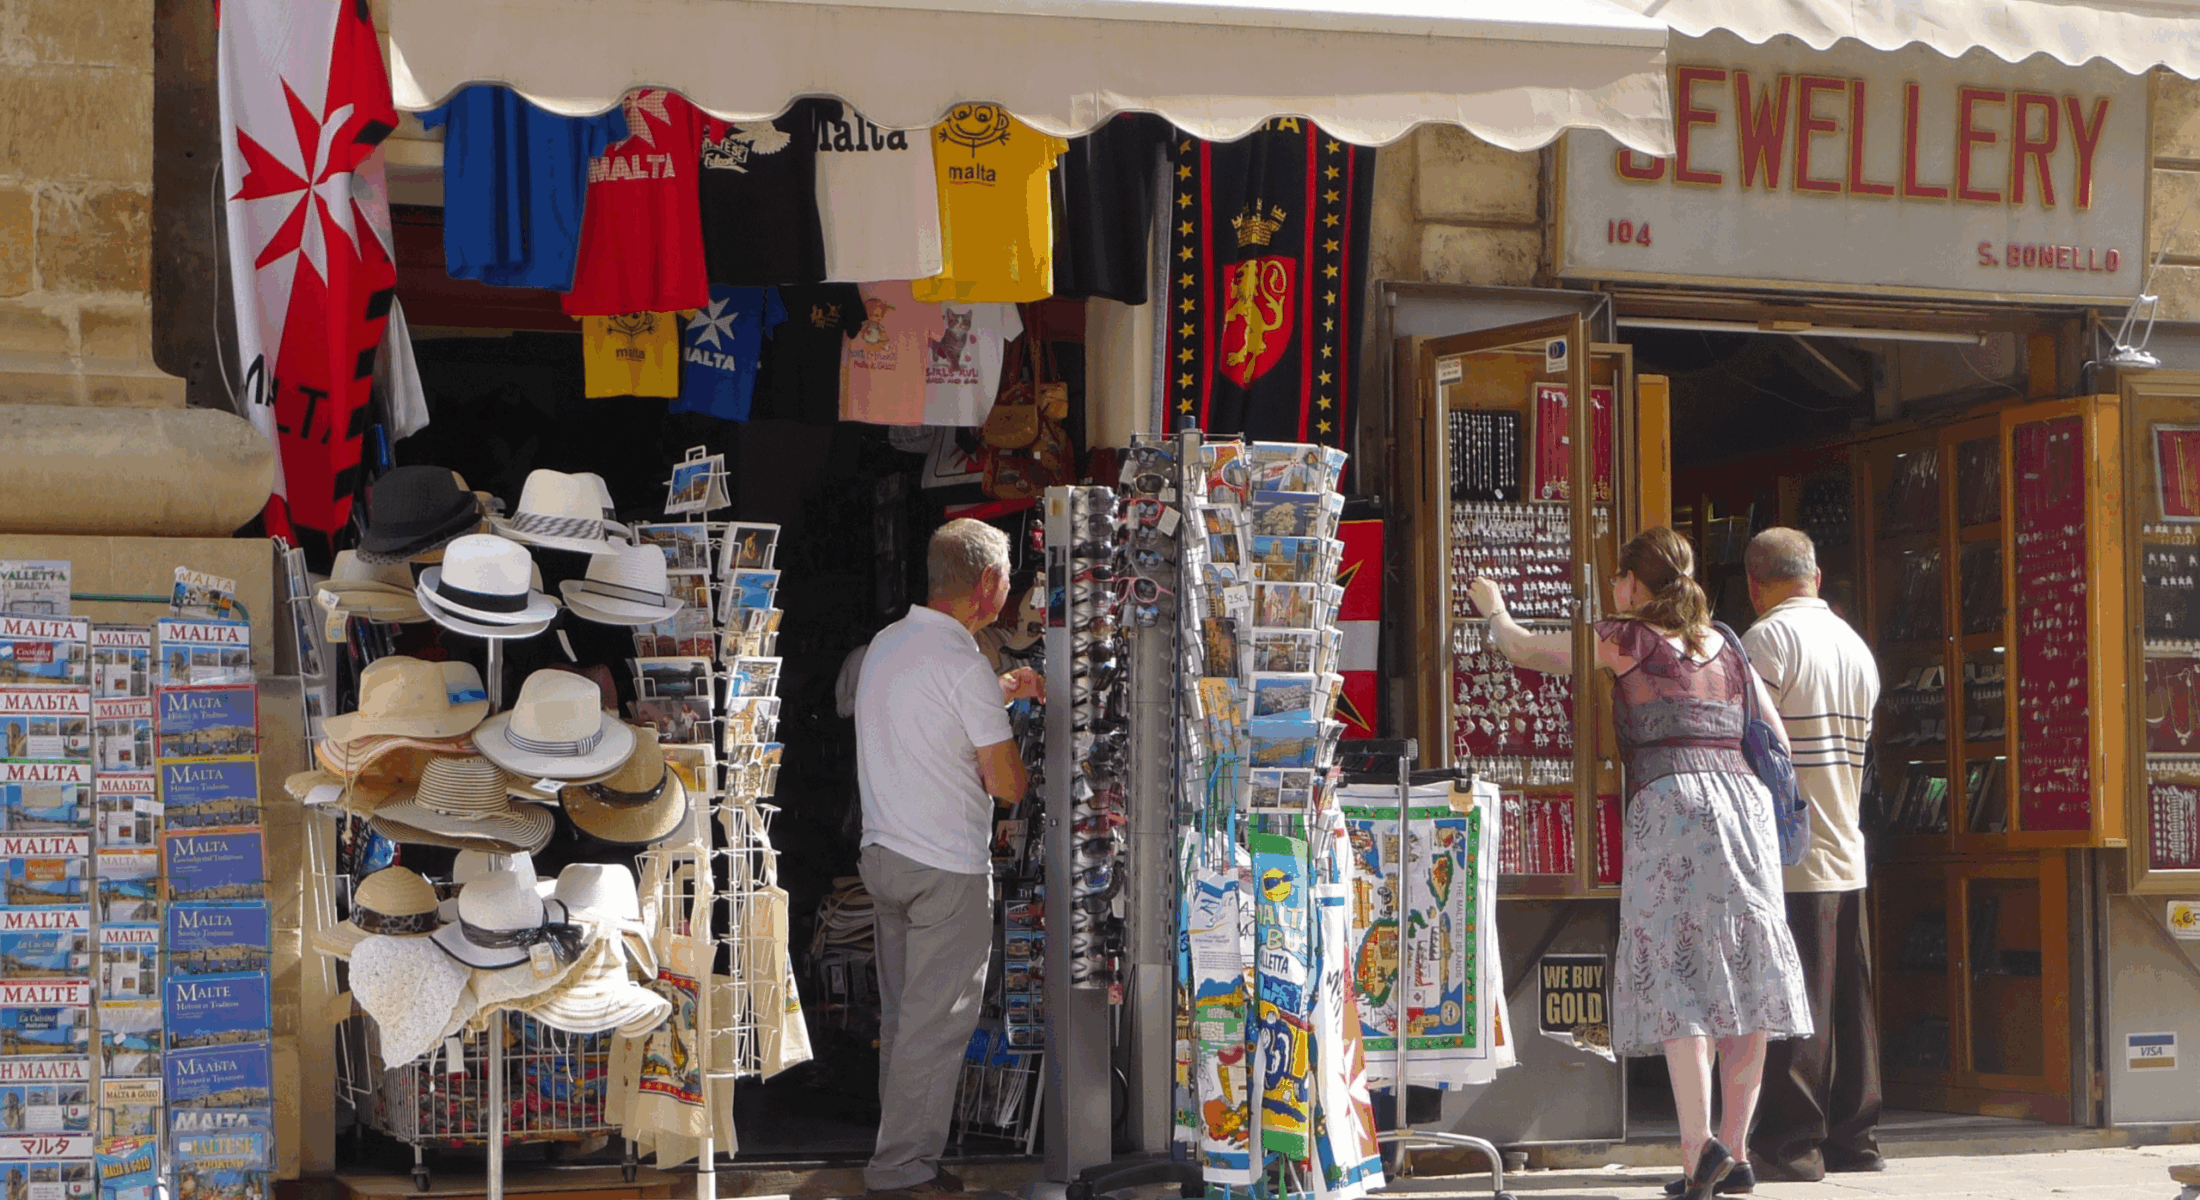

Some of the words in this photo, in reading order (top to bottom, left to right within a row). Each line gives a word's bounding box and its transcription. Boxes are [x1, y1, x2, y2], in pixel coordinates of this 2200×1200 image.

[1616, 66, 2109, 210] EWELLERY
[589, 152, 676, 183] MALTA
[949, 162, 996, 182] malta
[1608, 219, 1652, 247] 104
[1978, 242, 1998, 267] S.
[2006, 243, 2121, 272] BONELLO
[0, 570, 67, 581] VALLETTA
[180, 571, 234, 592] MALTA
[4, 619, 77, 639] MALTA
[170, 625, 240, 642] MALTA
[98, 633, 145, 645] MALTA
[5, 694, 80, 711] МАЛЬТА
[100, 702, 147, 716] MALTE
[168, 693, 222, 711] MALTA
[8, 764, 81, 782] MALTA
[170, 765, 223, 784] MALTA
[101, 780, 151, 791] МАЛЬТА
[4, 838, 79, 855] MALTA
[174, 838, 228, 856] MALTA
[5, 912, 80, 929] MALTA
[178, 911, 233, 929] MALTA
[106, 930, 154, 942] MALTA
[1543, 965, 1569, 988] WE
[1572, 965, 1604, 988] BUY
[4, 986, 79, 1003] MALTE
[176, 983, 231, 1002] MALTE
[1546, 992, 1603, 1024] GOLD
[2140, 1046, 2163, 1056] VISA
[106, 1090, 130, 1099] MALTA
[138, 1090, 158, 1098] GOZO
[176, 1112, 250, 1131] MALTA
[20, 1136, 71, 1155] マルタ
